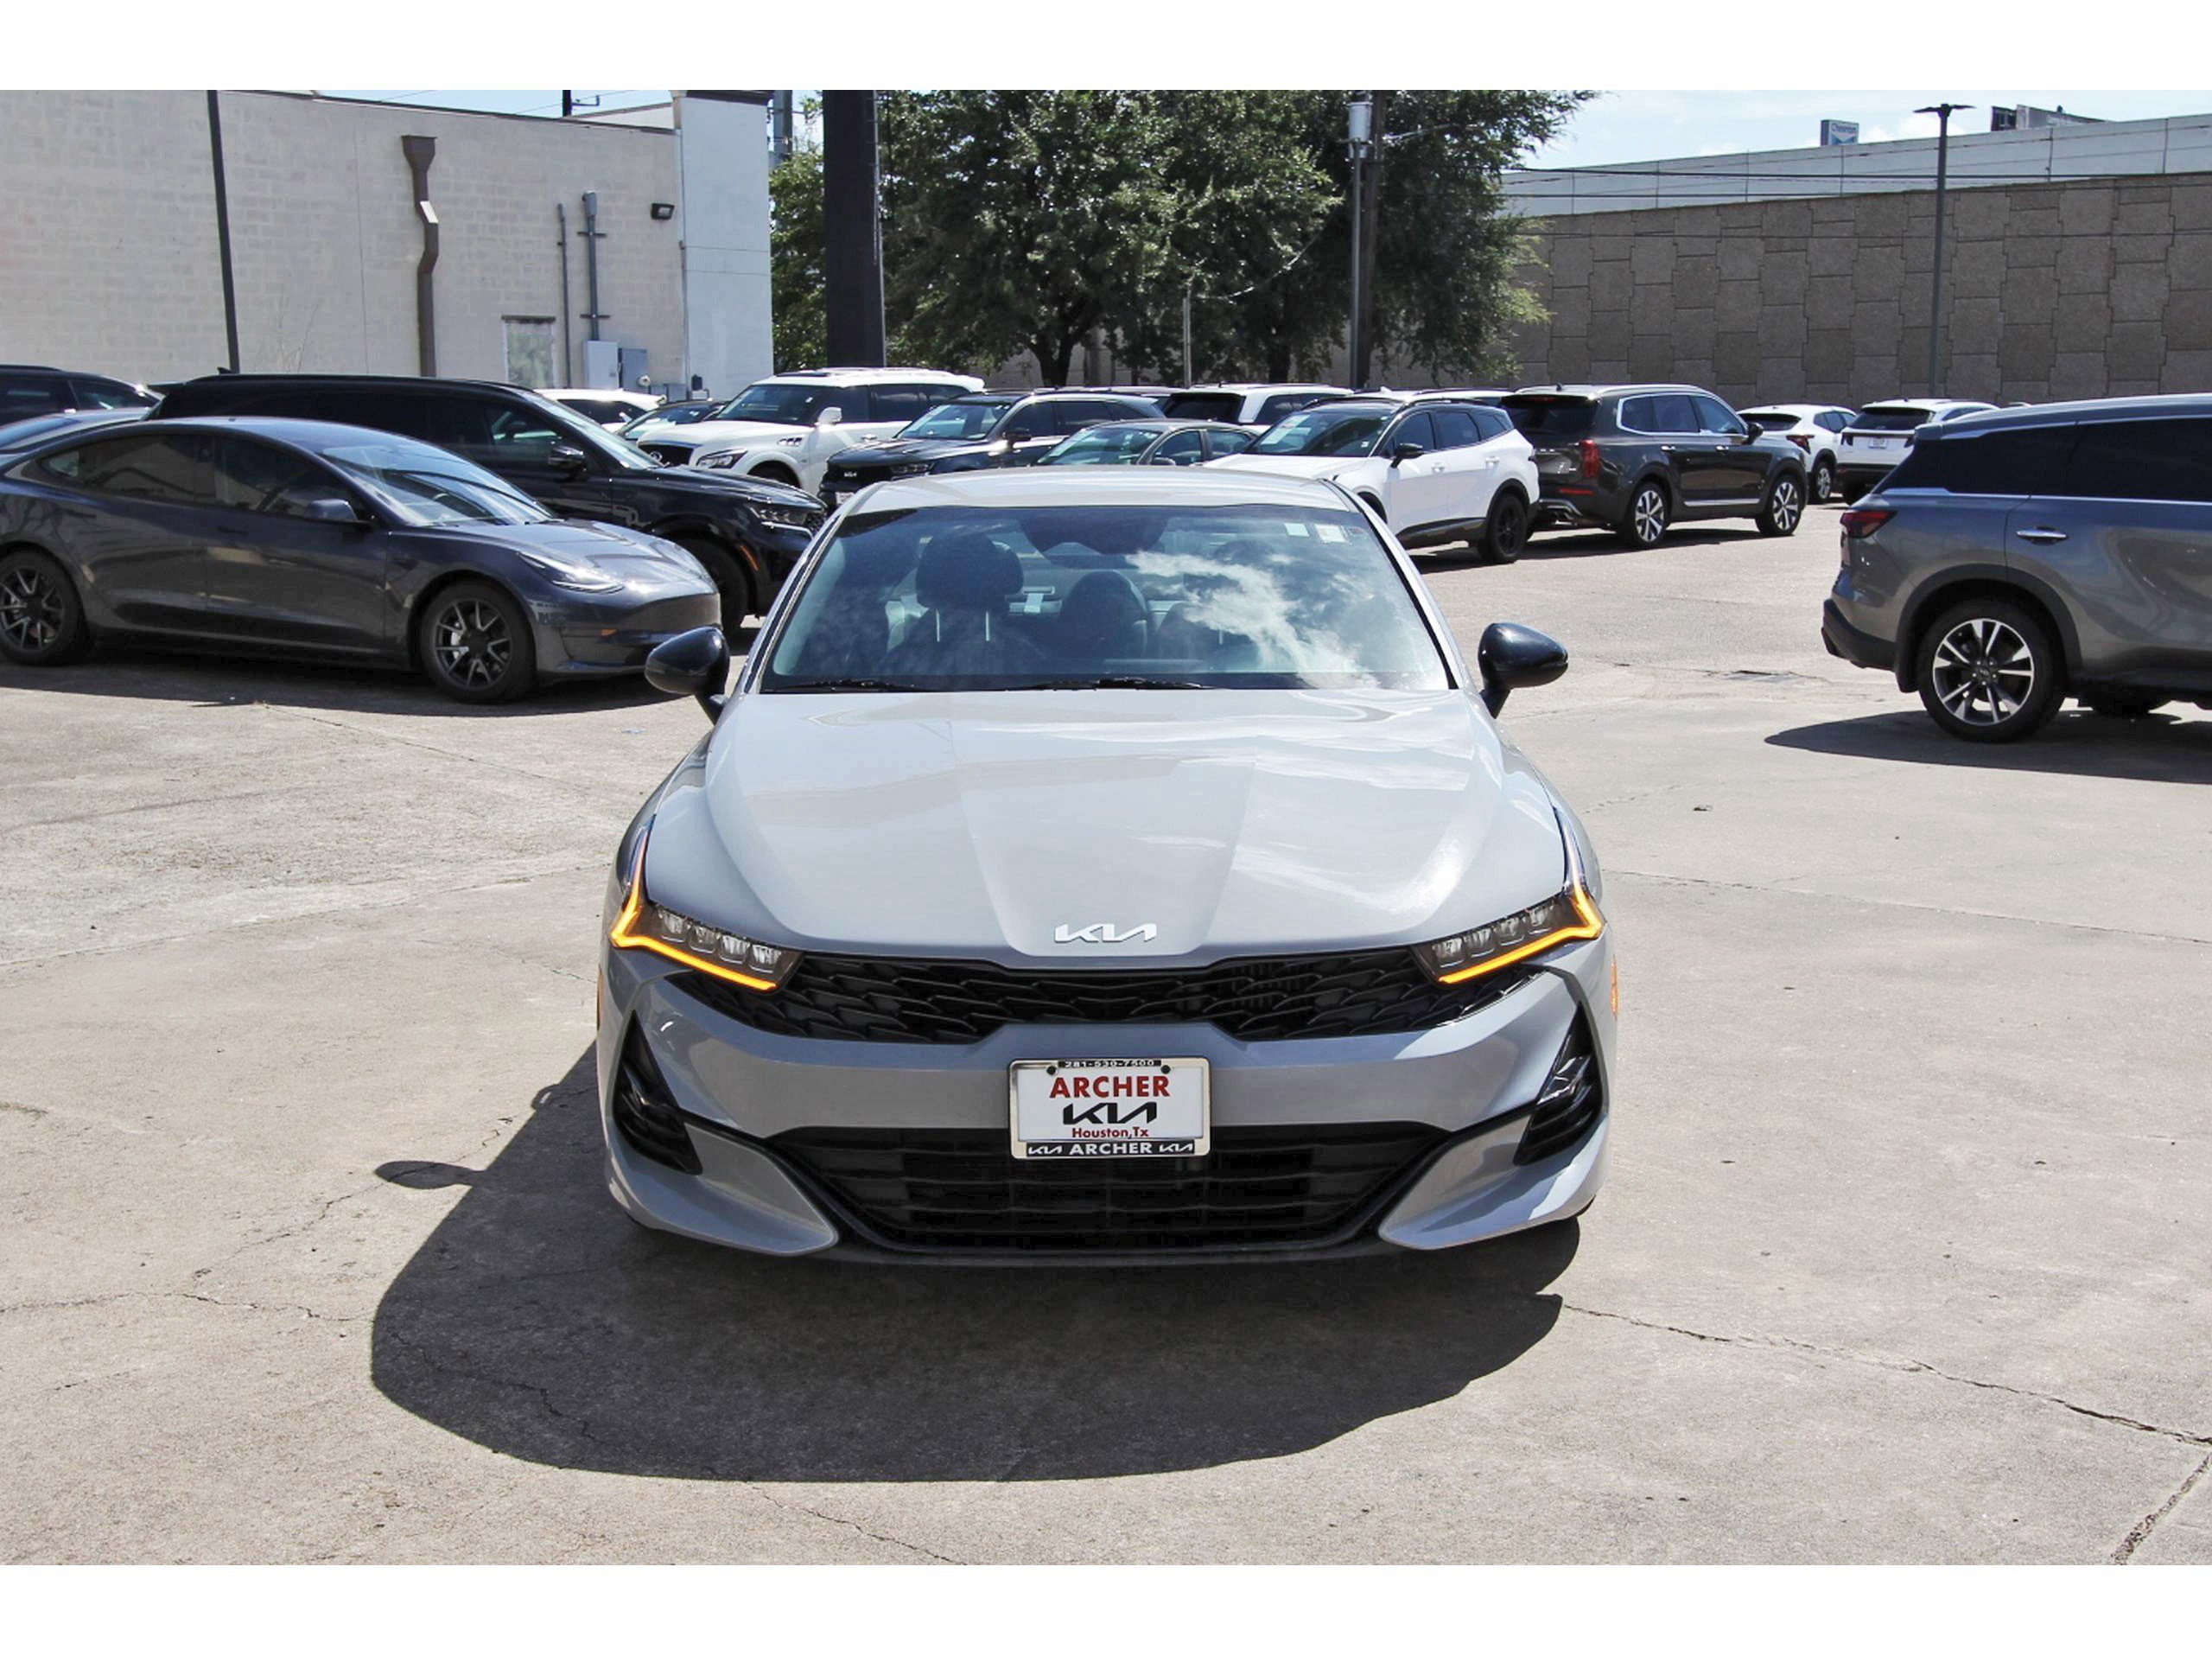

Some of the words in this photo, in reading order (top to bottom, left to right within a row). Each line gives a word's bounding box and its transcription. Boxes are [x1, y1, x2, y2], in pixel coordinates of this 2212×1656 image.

[1055, 923, 1157, 943] KIA
[1049, 1076, 1170, 1098] ARCHER
[1063, 1102, 1157, 1124] KIA
[1072, 1126, 1148, 1139] Houston,Tx
[1028, 1145, 1063, 1156] KIA
[1069, 1143, 1153, 1155] ARCHER
[1159, 1142, 1193, 1153] KIA
